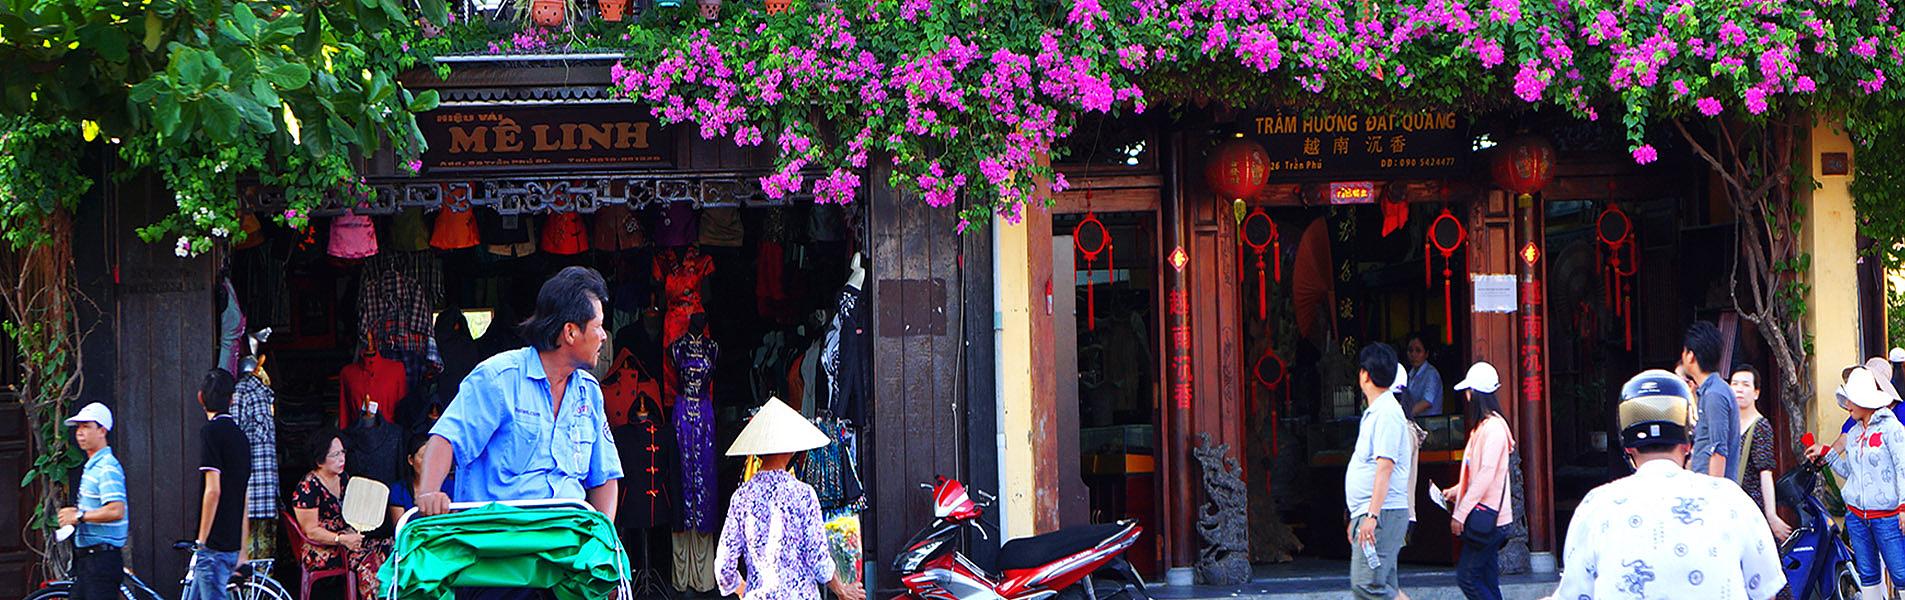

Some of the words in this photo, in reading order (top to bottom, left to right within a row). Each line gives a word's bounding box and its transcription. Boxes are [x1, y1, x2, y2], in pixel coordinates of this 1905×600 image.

[449, 117, 524, 154] MÊ
[532, 122, 650, 152] LINH
[1303, 135, 1407, 156] 越南沉香
